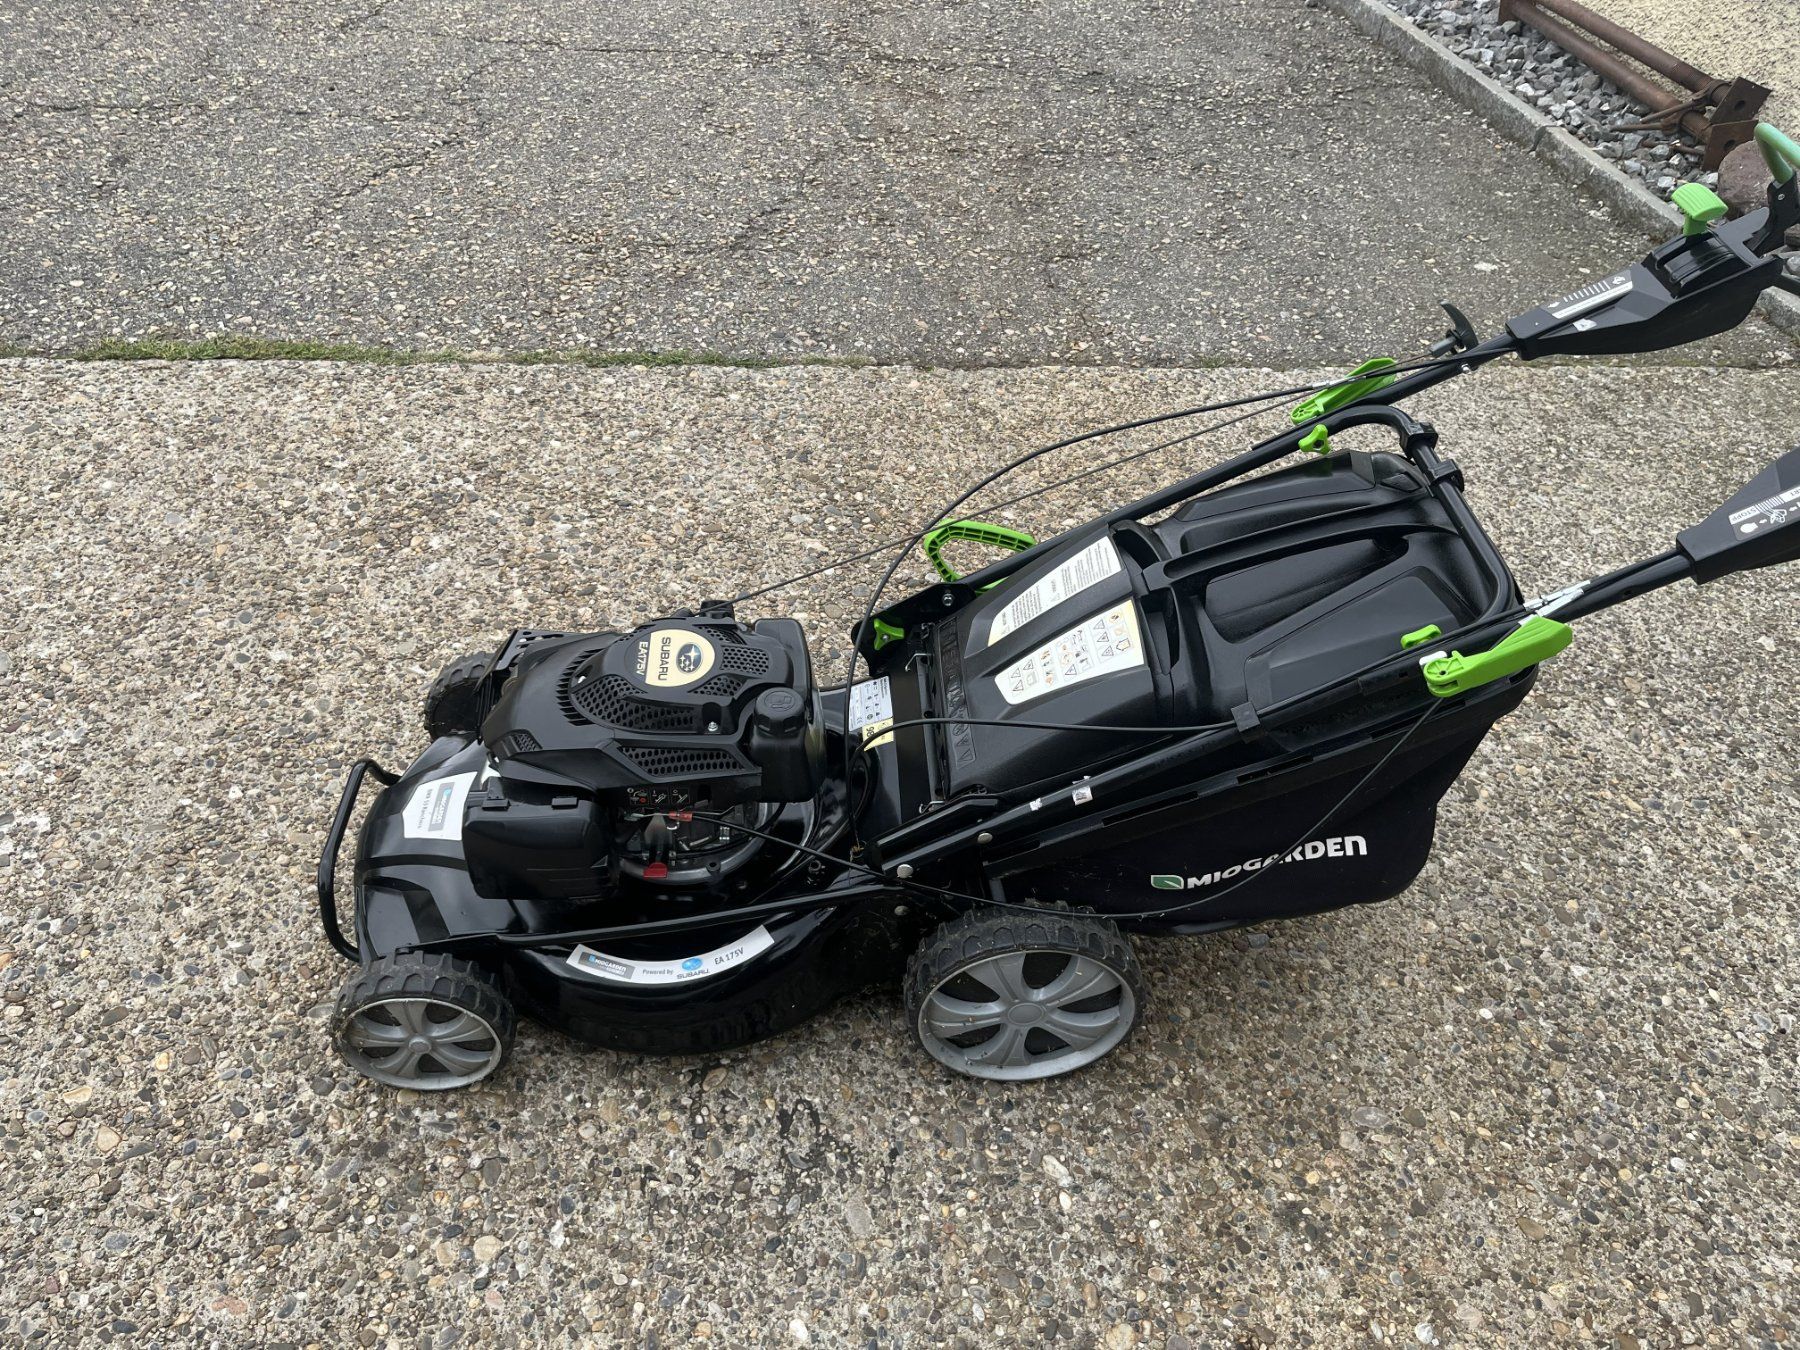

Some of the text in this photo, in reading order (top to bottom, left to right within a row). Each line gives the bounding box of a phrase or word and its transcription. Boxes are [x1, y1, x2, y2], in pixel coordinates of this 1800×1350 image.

[636, 641, 649, 676] EA175V
[657, 636, 671, 681] SUBARU
[714, 946, 744, 965] EA 175V
[676, 968, 709, 980] SUBARU
